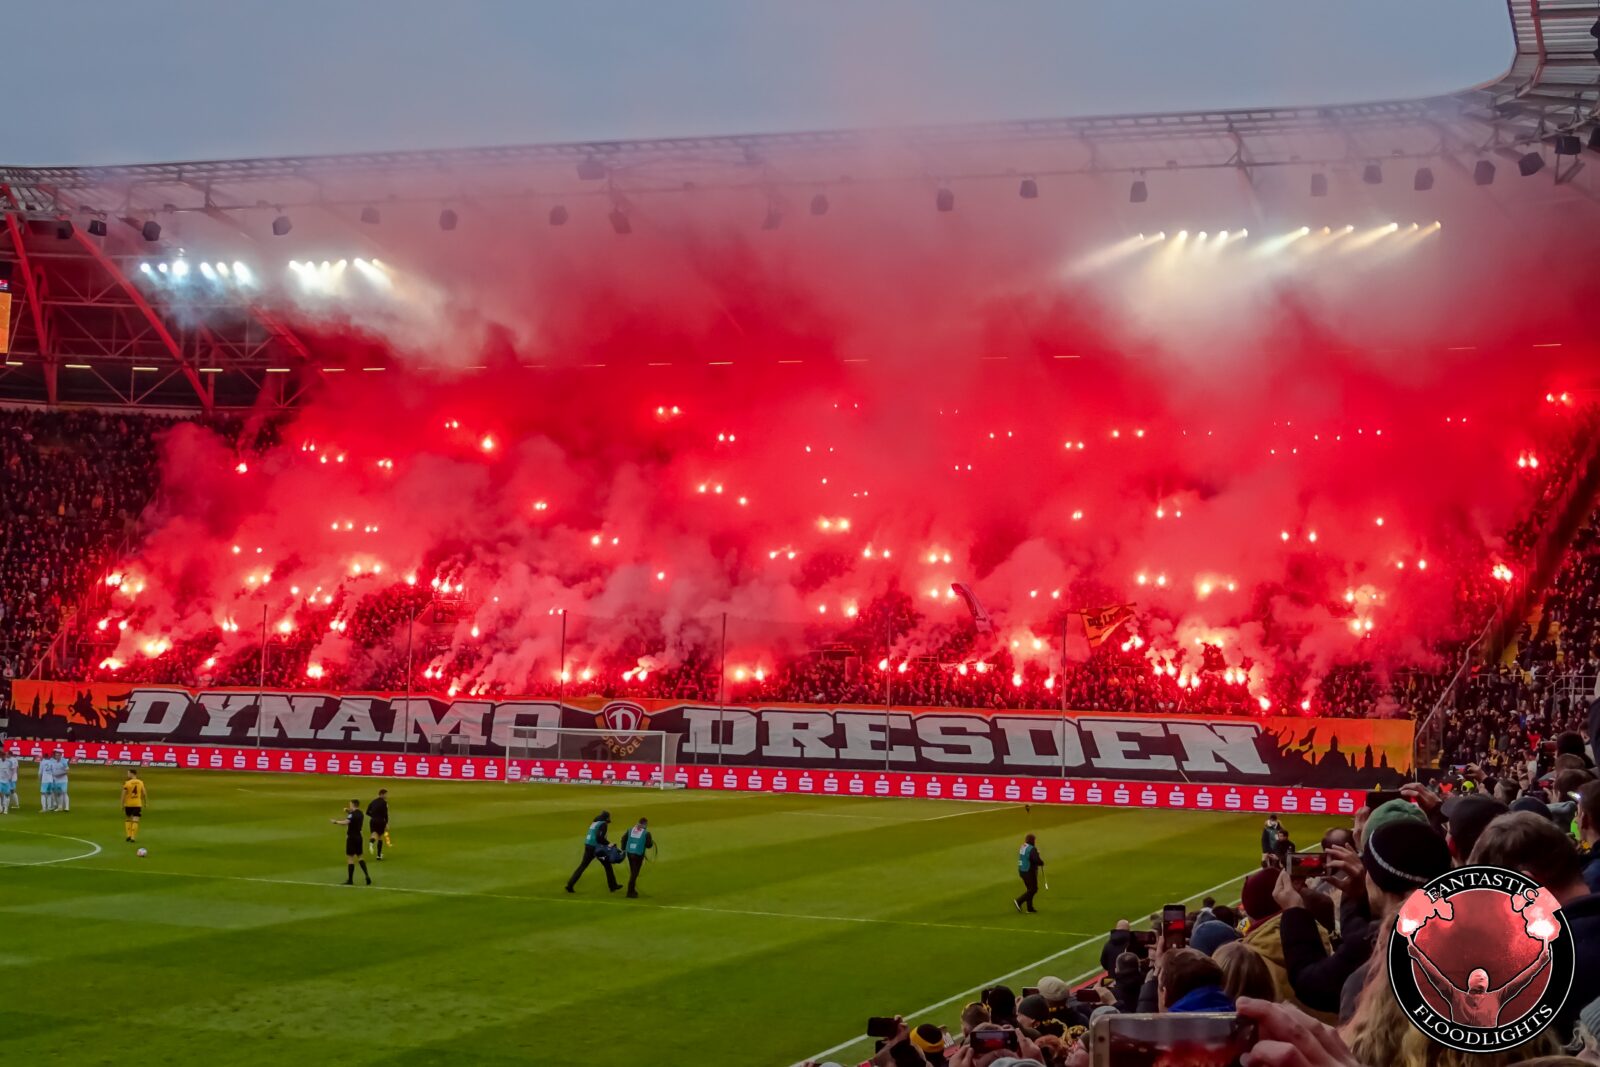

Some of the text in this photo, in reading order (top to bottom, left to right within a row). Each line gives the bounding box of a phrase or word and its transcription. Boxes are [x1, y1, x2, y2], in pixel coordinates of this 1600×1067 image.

[117, 690, 1271, 775] DYNAMO DRESDEN
[131, 784, 139, 796] 4
